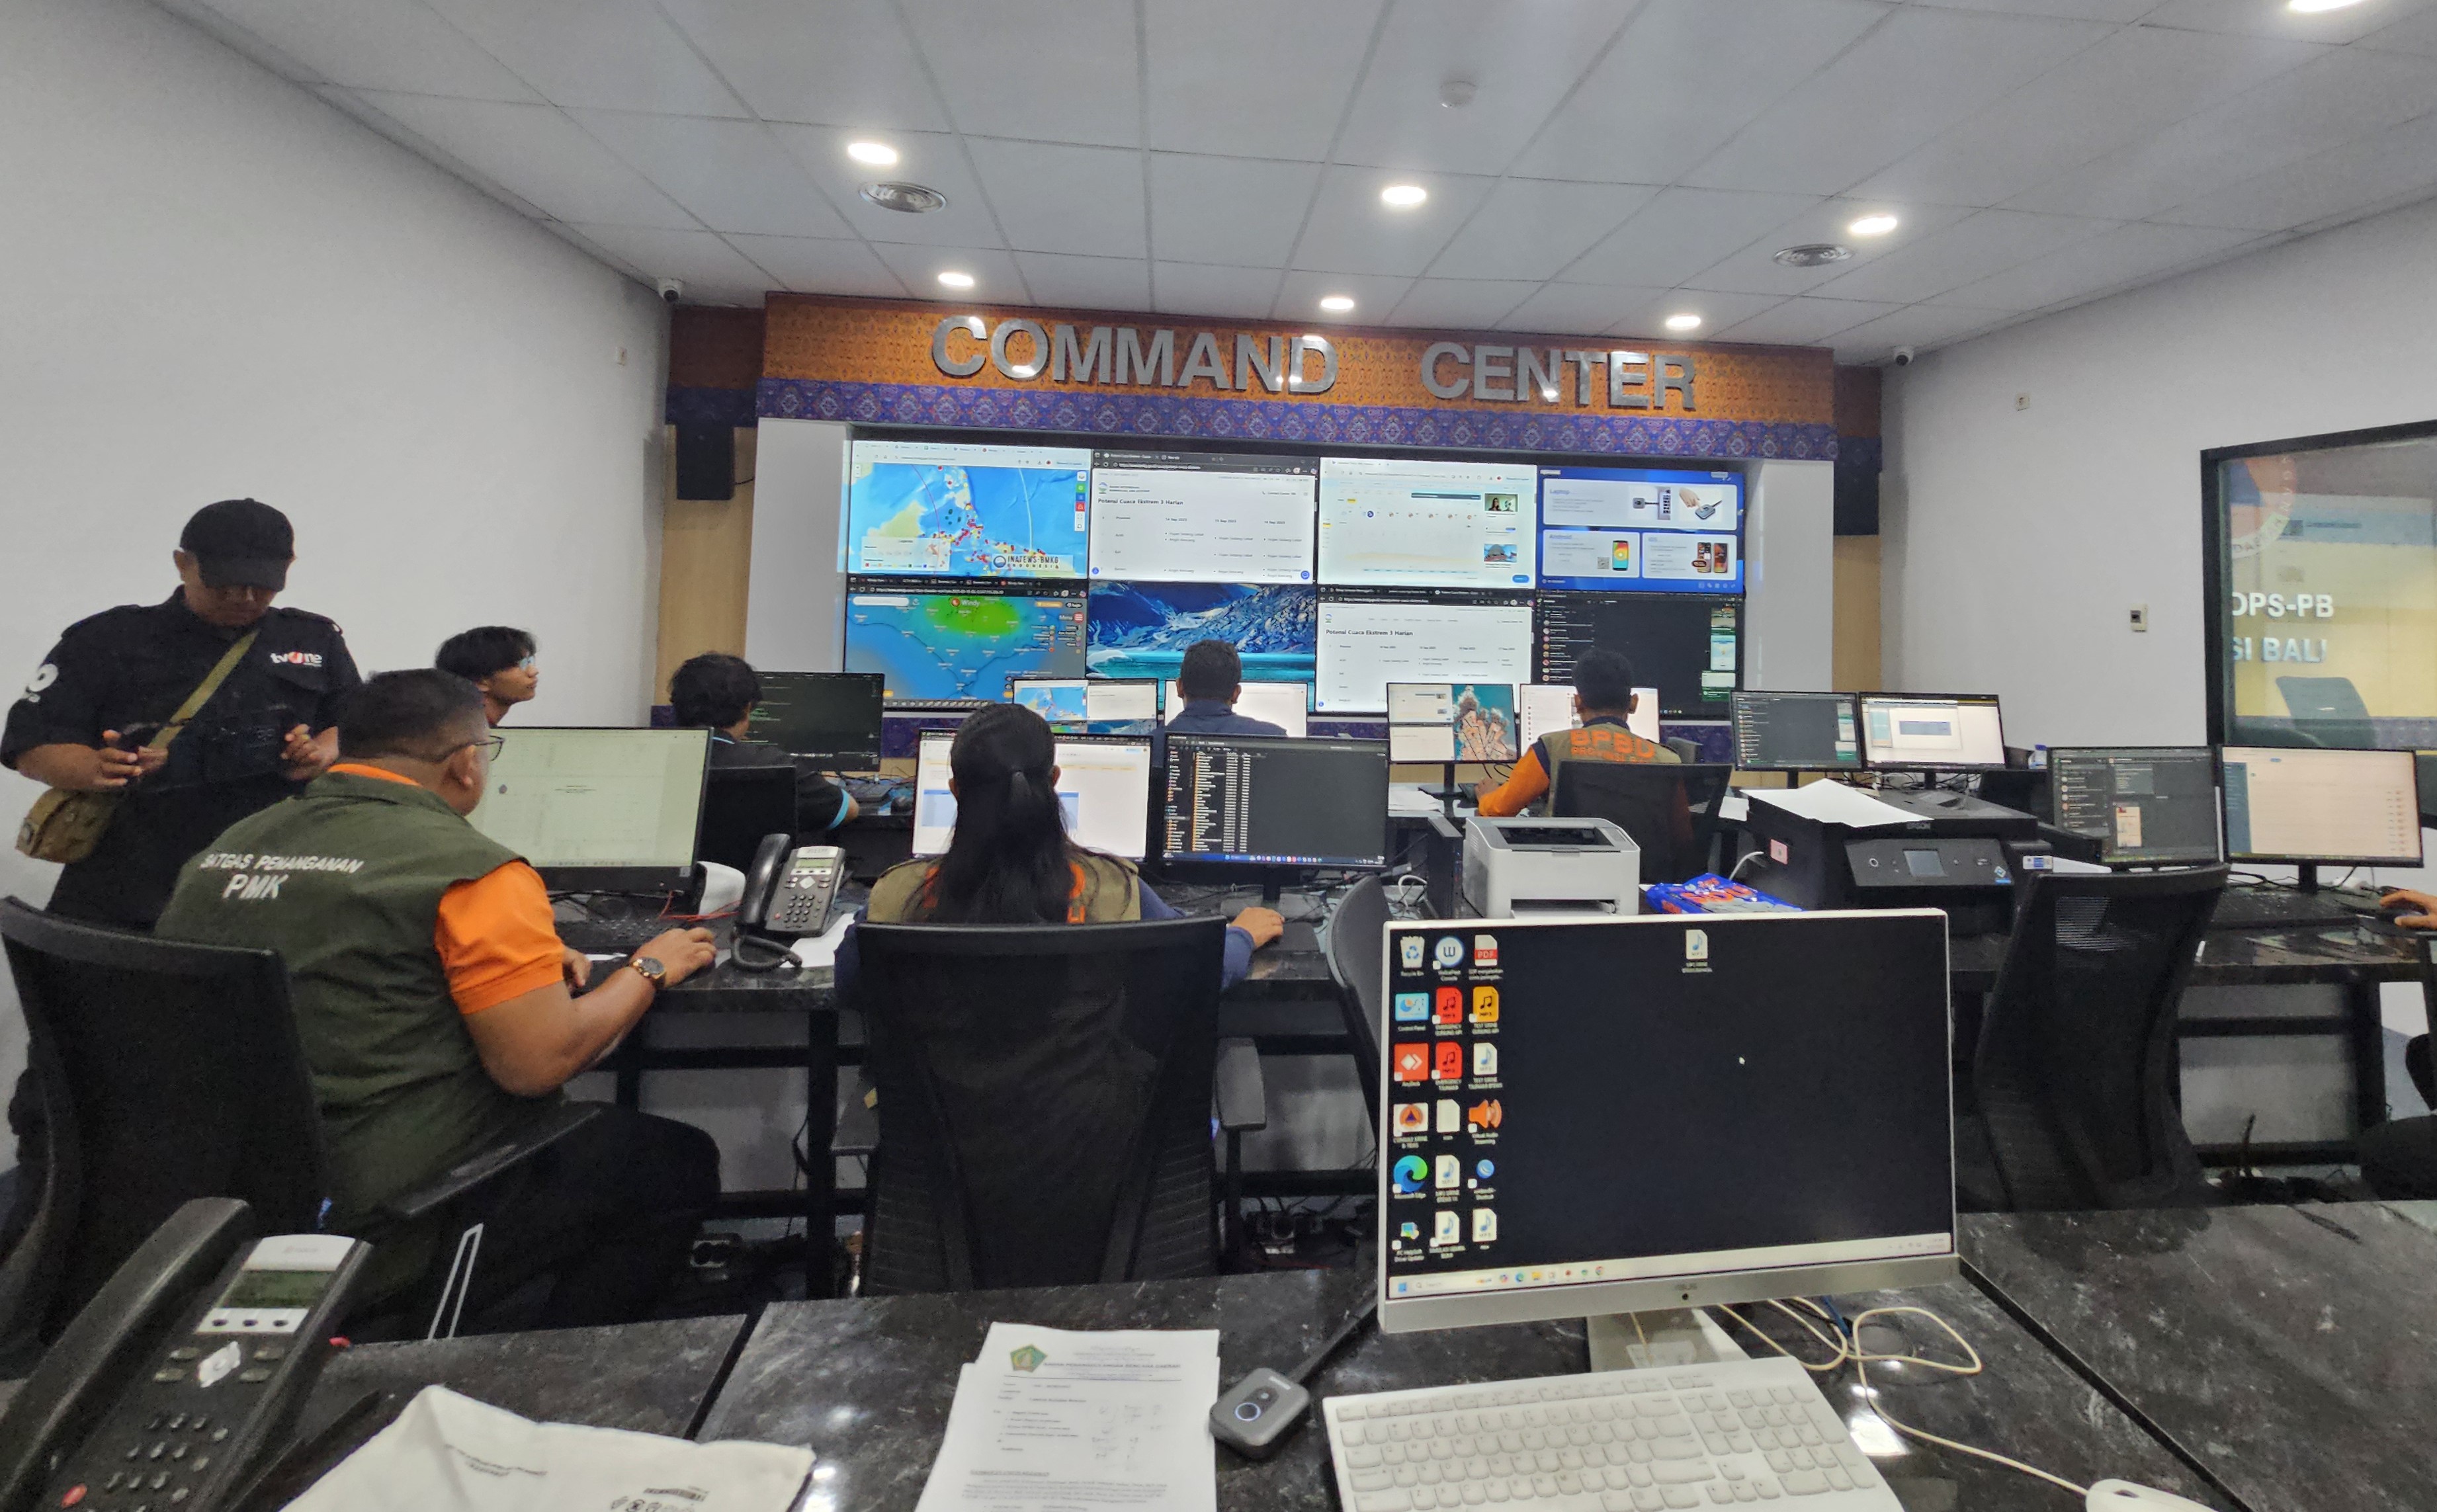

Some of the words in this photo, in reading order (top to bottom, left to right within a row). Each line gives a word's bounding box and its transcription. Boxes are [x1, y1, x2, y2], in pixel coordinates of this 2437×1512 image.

[932, 315, 1337, 395] COMMAND
[1421, 341, 1695, 410] CENTER
[1007, 556, 1058, 564] INATEWS-BMKG
[2263, 637, 2328, 662] BALI
[1570, 729, 1655, 759] BPBD
[254, 855, 364, 874] PENANGANAN
[222, 874, 289, 900] PMK
